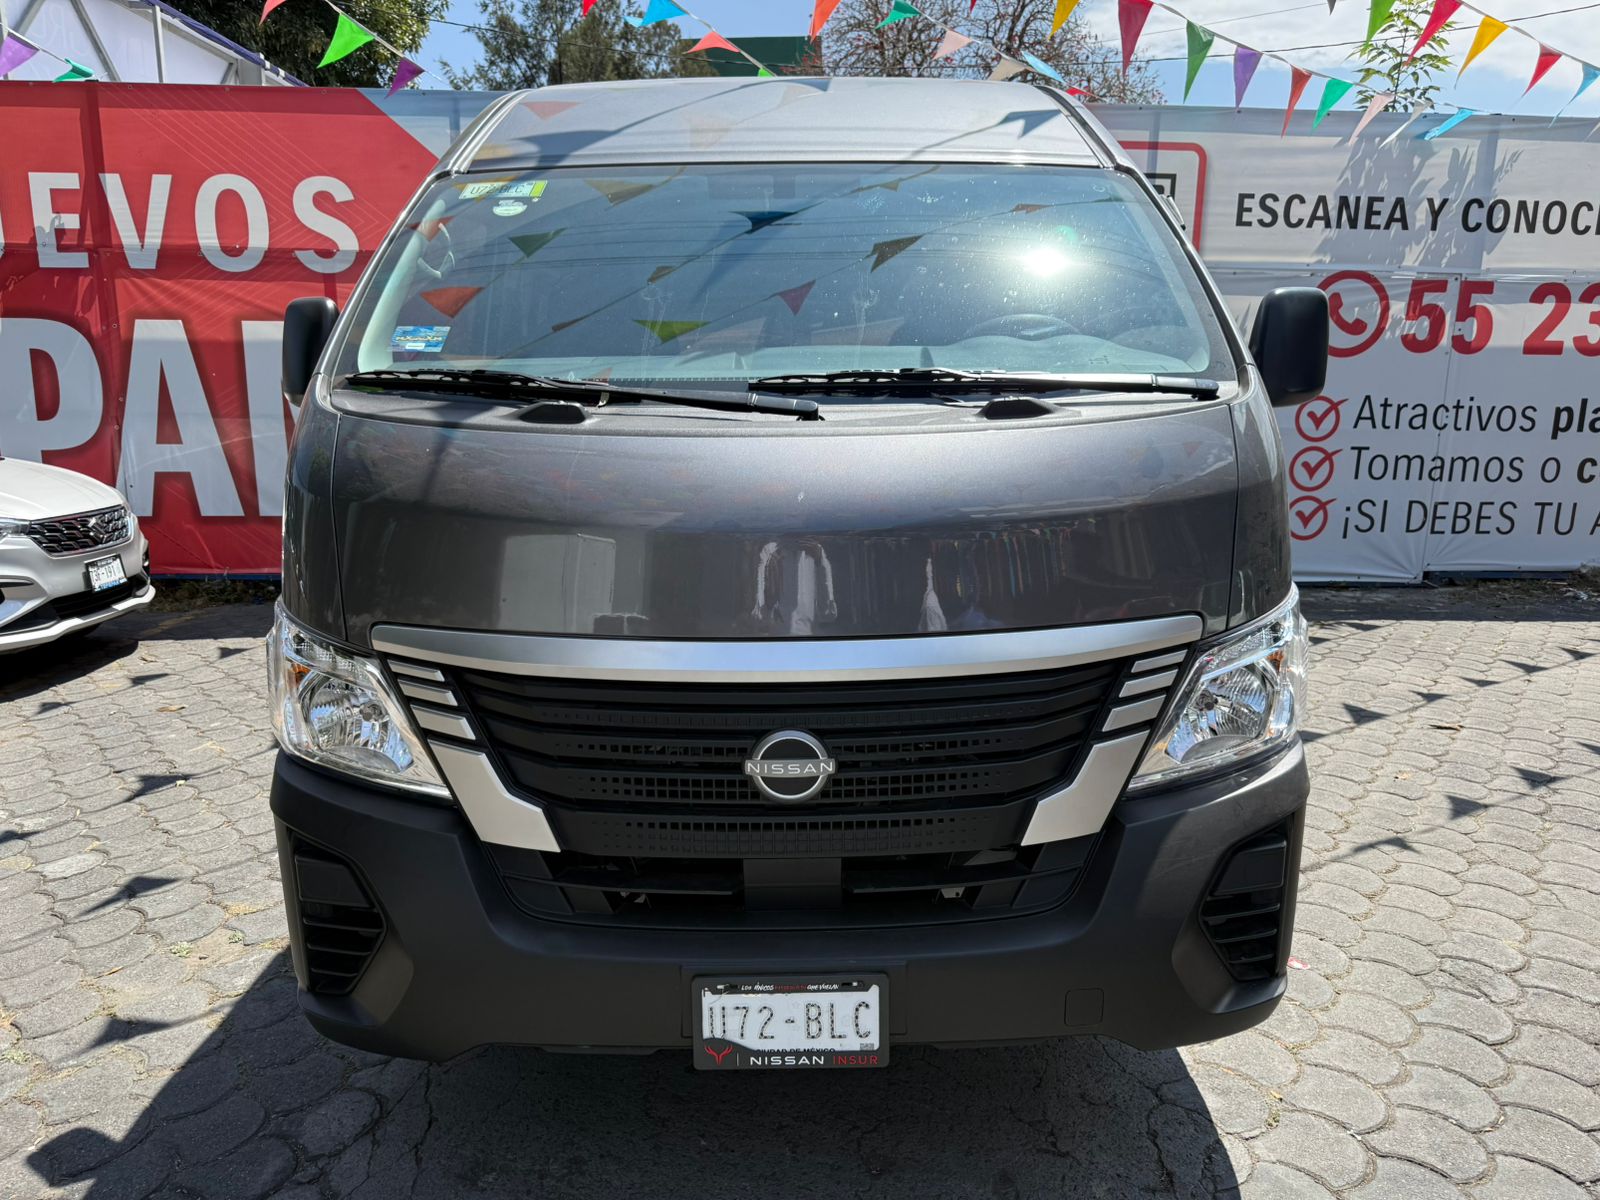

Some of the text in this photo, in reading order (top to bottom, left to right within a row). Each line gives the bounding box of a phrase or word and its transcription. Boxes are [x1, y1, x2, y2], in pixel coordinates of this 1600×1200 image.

[0, 172, 360, 273] EVOS
[1235, 193, 1409, 231] ESCANEA
[1426, 197, 1450, 232] Y
[1400, 279, 1495, 355] 55
[1352, 394, 1538, 433] Atractivos
[1350, 446, 1600, 484] Tomamos o c
[1404, 500, 1518, 535] DEBES
[1534, 501, 1578, 535] TU
[747, 761, 833, 774] NISSAN
[709, 1001, 871, 1038] U72-BLC
[750, 1055, 878, 1066] NISSAN INSUR
